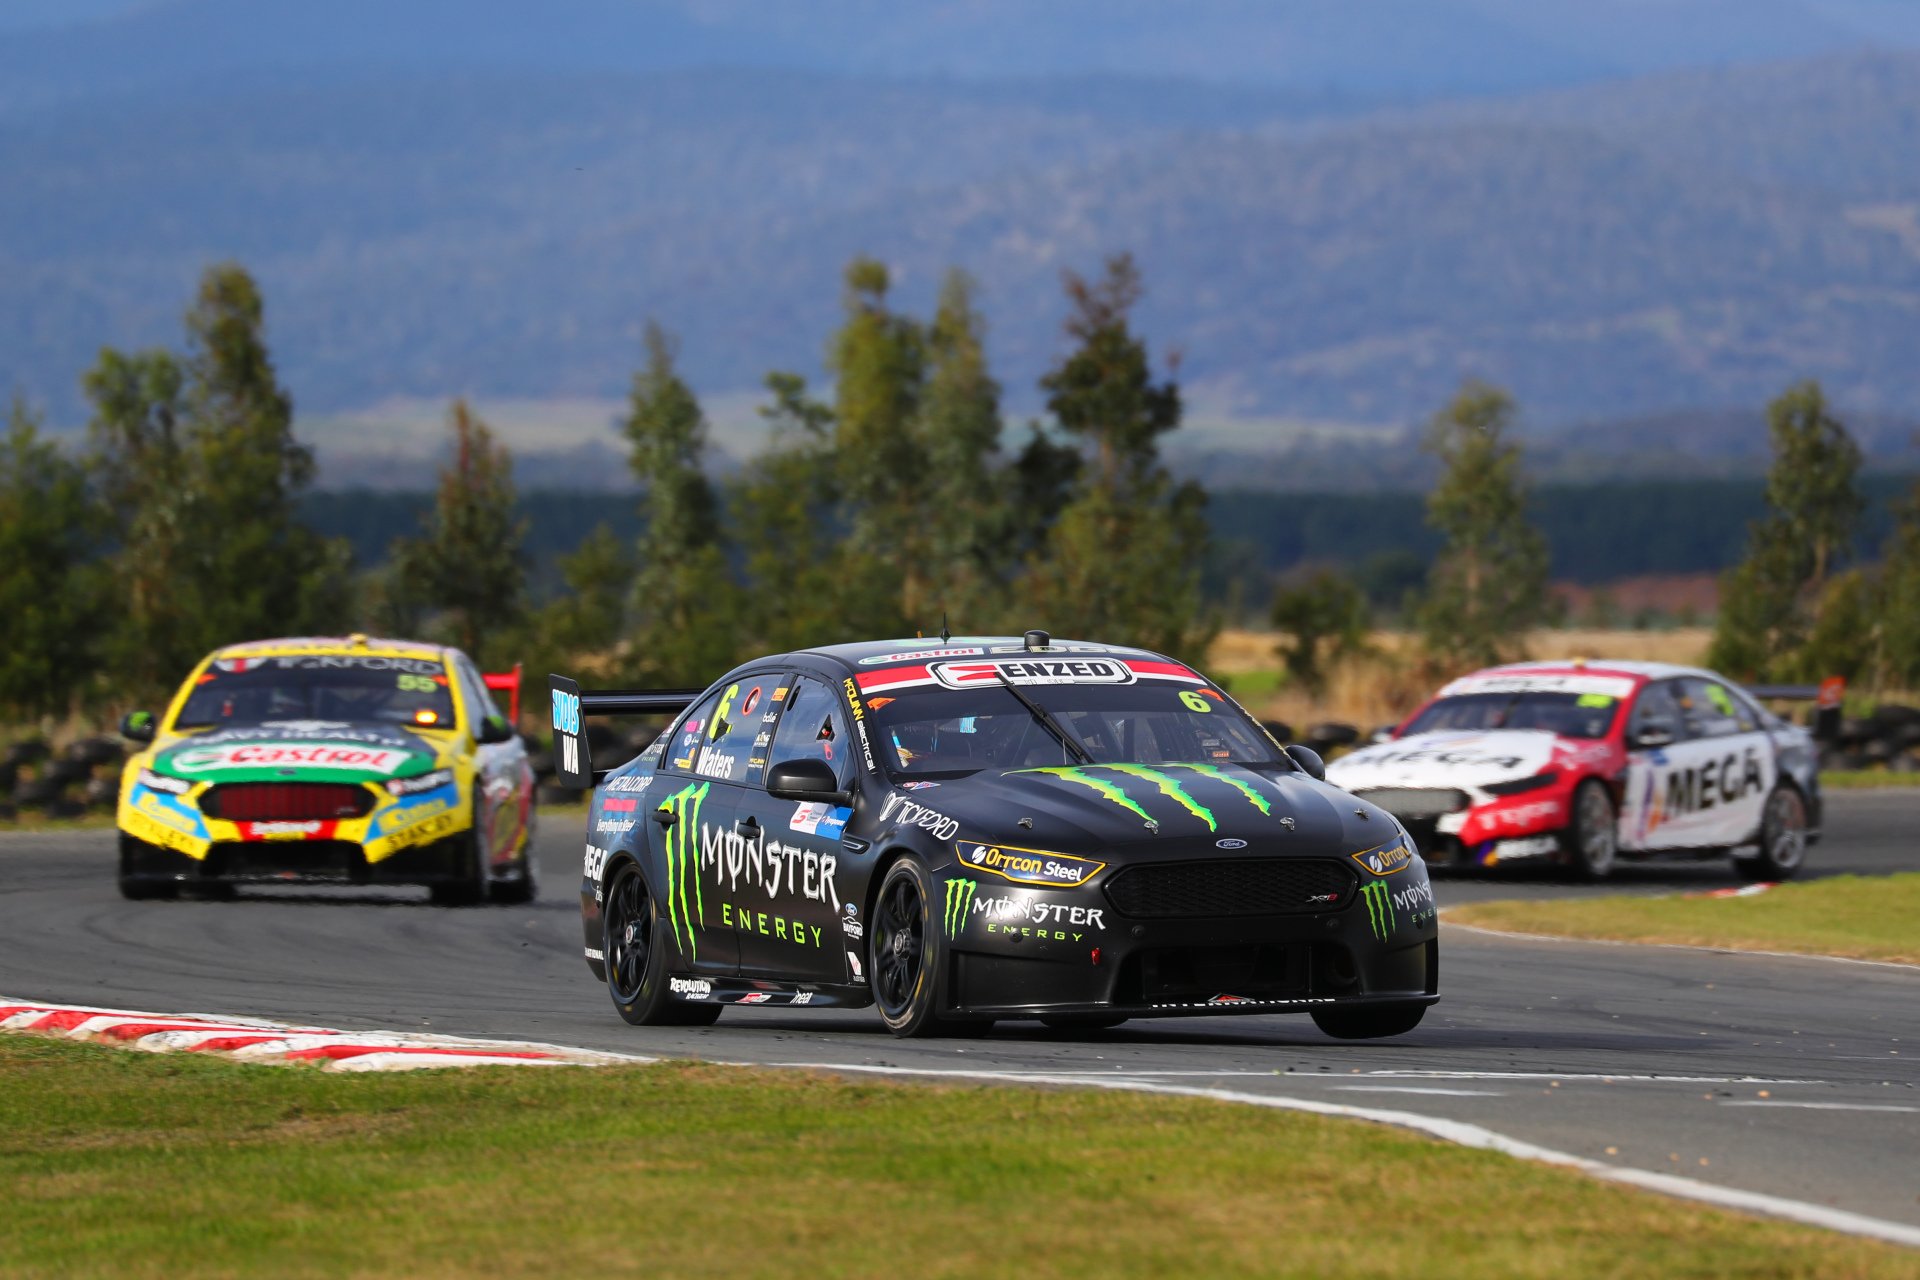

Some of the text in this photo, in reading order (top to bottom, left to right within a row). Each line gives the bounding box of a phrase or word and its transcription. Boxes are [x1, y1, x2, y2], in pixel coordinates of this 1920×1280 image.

[397, 673, 438, 693] 55
[999, 662, 1115, 678] ENZED
[1178, 690, 1212, 713] 6
[229, 747, 393, 767] Castrol
[562, 734, 579, 775] WA
[857, 720, 876, 771] electrical
[695, 746, 735, 779] Waters
[604, 776, 654, 792] METALCORP
[700, 819, 841, 914] MONSTER
[986, 847, 1083, 882] Orrcon Steel
[722, 902, 822, 948] ENERGY
[972, 896, 1106, 930] MONSTER
[987, 923, 1084, 943] ENERGY
[670, 977, 711, 994] REVOLUTION
